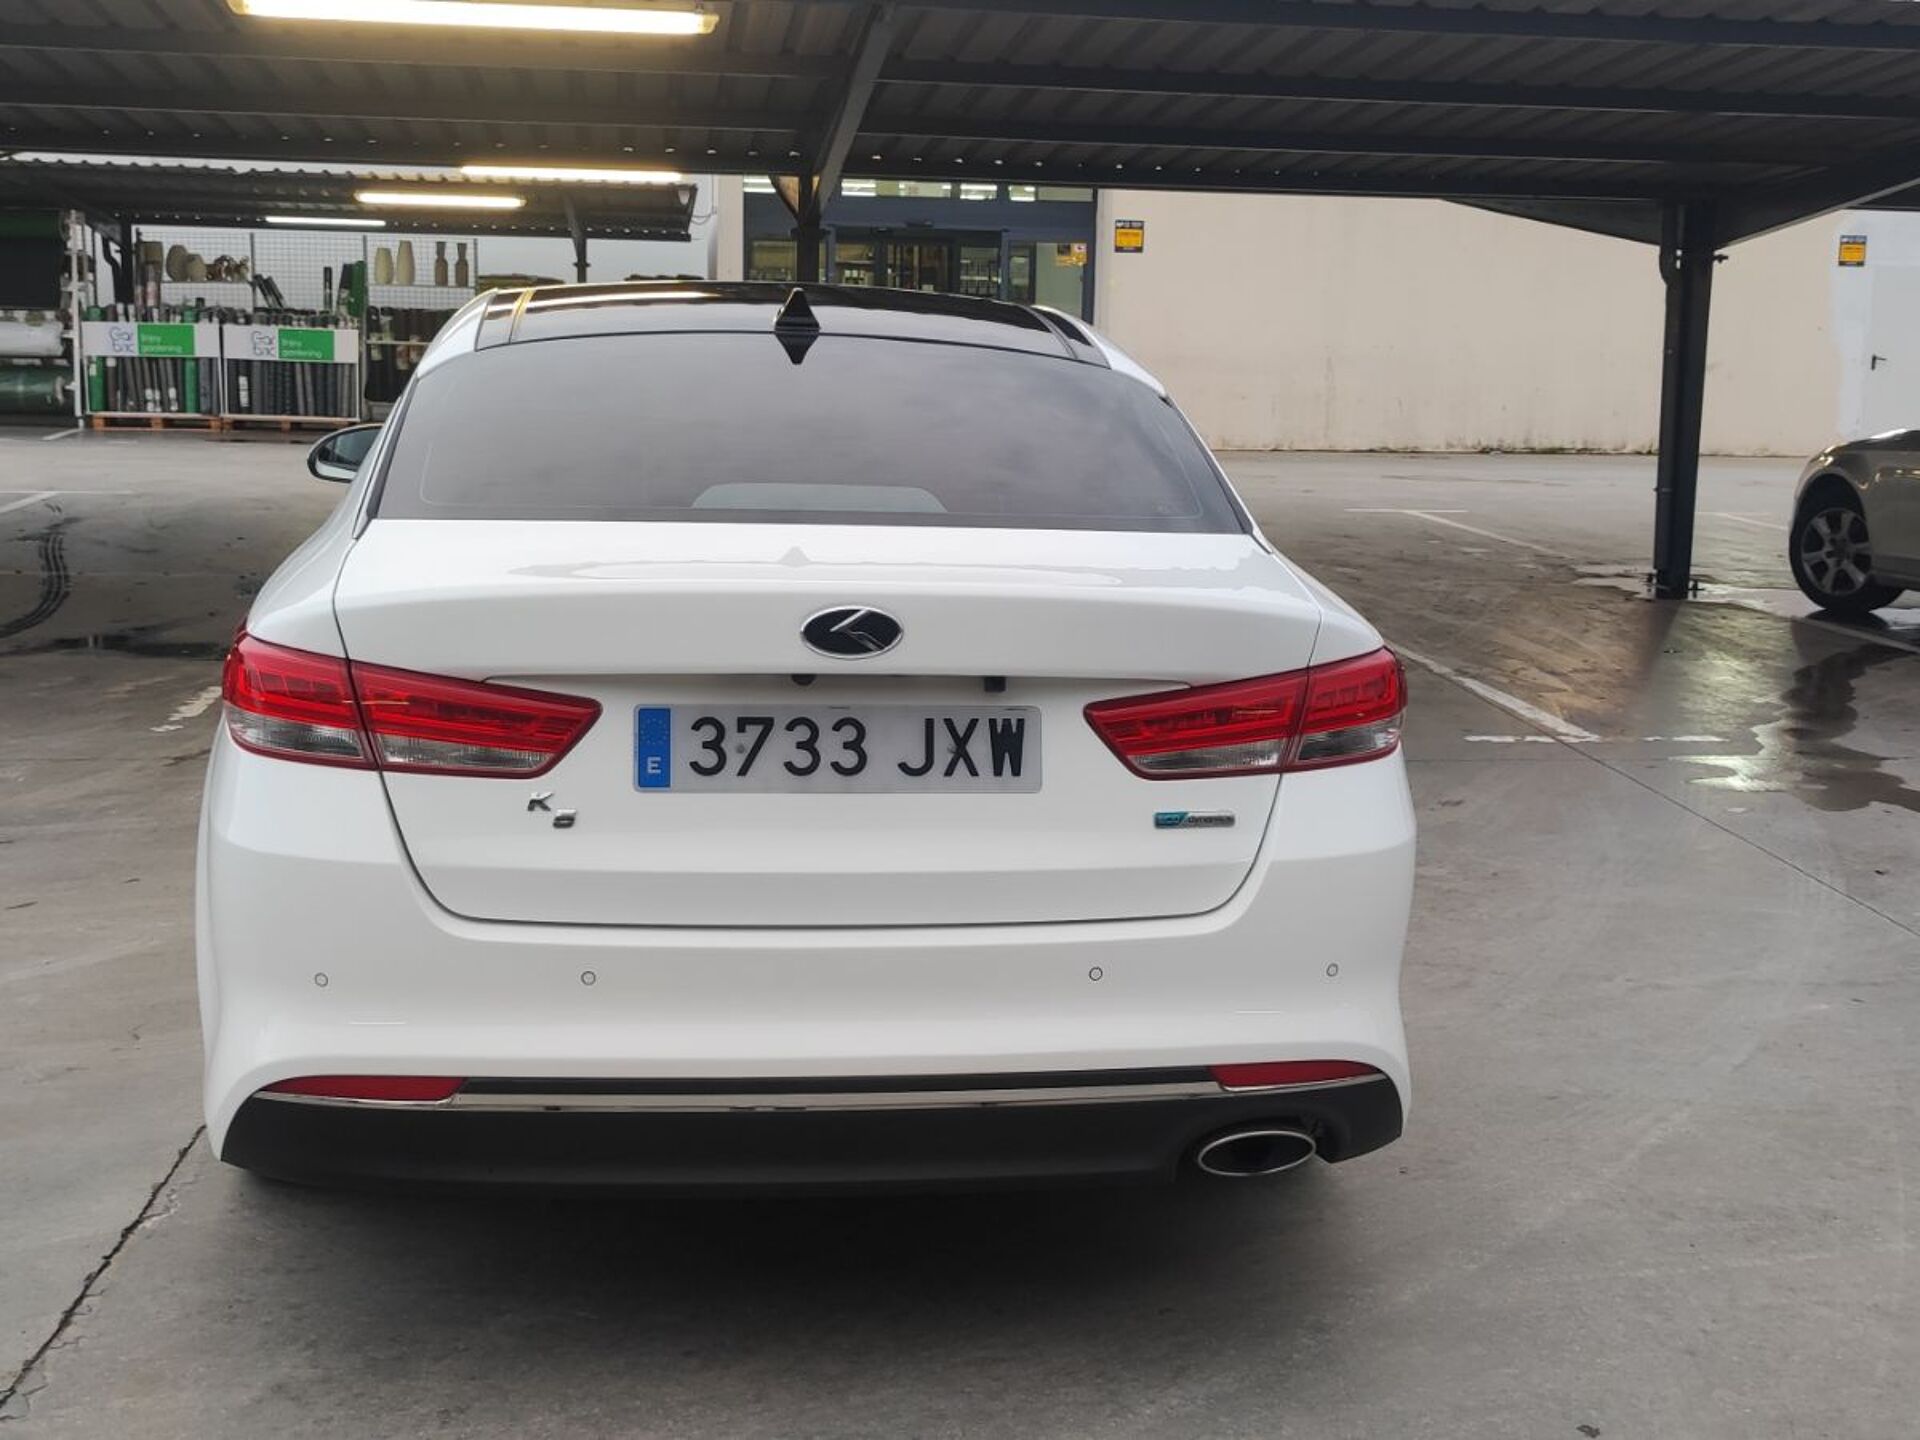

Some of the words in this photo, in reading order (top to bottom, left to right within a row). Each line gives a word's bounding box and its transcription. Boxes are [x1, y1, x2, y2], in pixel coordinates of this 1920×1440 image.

[647, 756, 662, 774] E
[689, 716, 868, 777] 3733
[897, 717, 1026, 777] JXW
